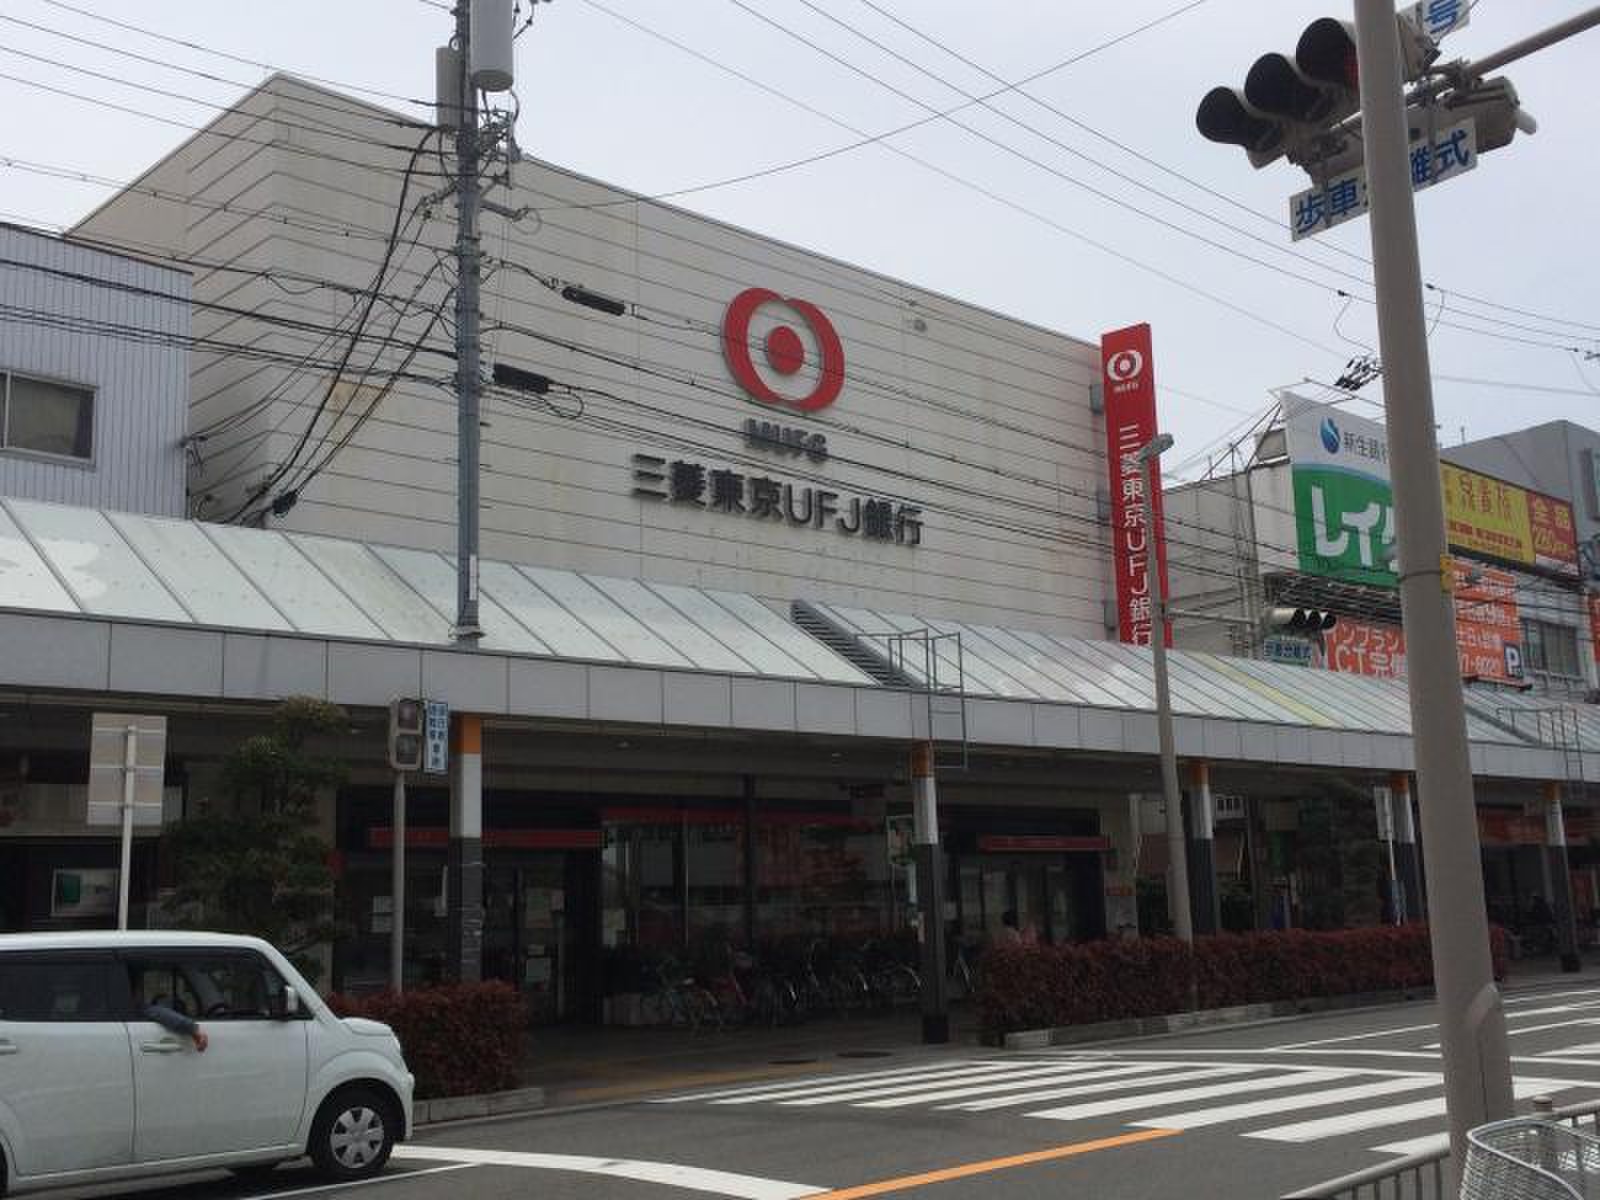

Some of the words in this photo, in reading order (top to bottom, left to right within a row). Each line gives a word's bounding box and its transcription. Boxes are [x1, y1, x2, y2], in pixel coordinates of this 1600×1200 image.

[631, 453, 924, 546] 三菱東京UFJ銀行
[1505, 645, 1520, 677] P
